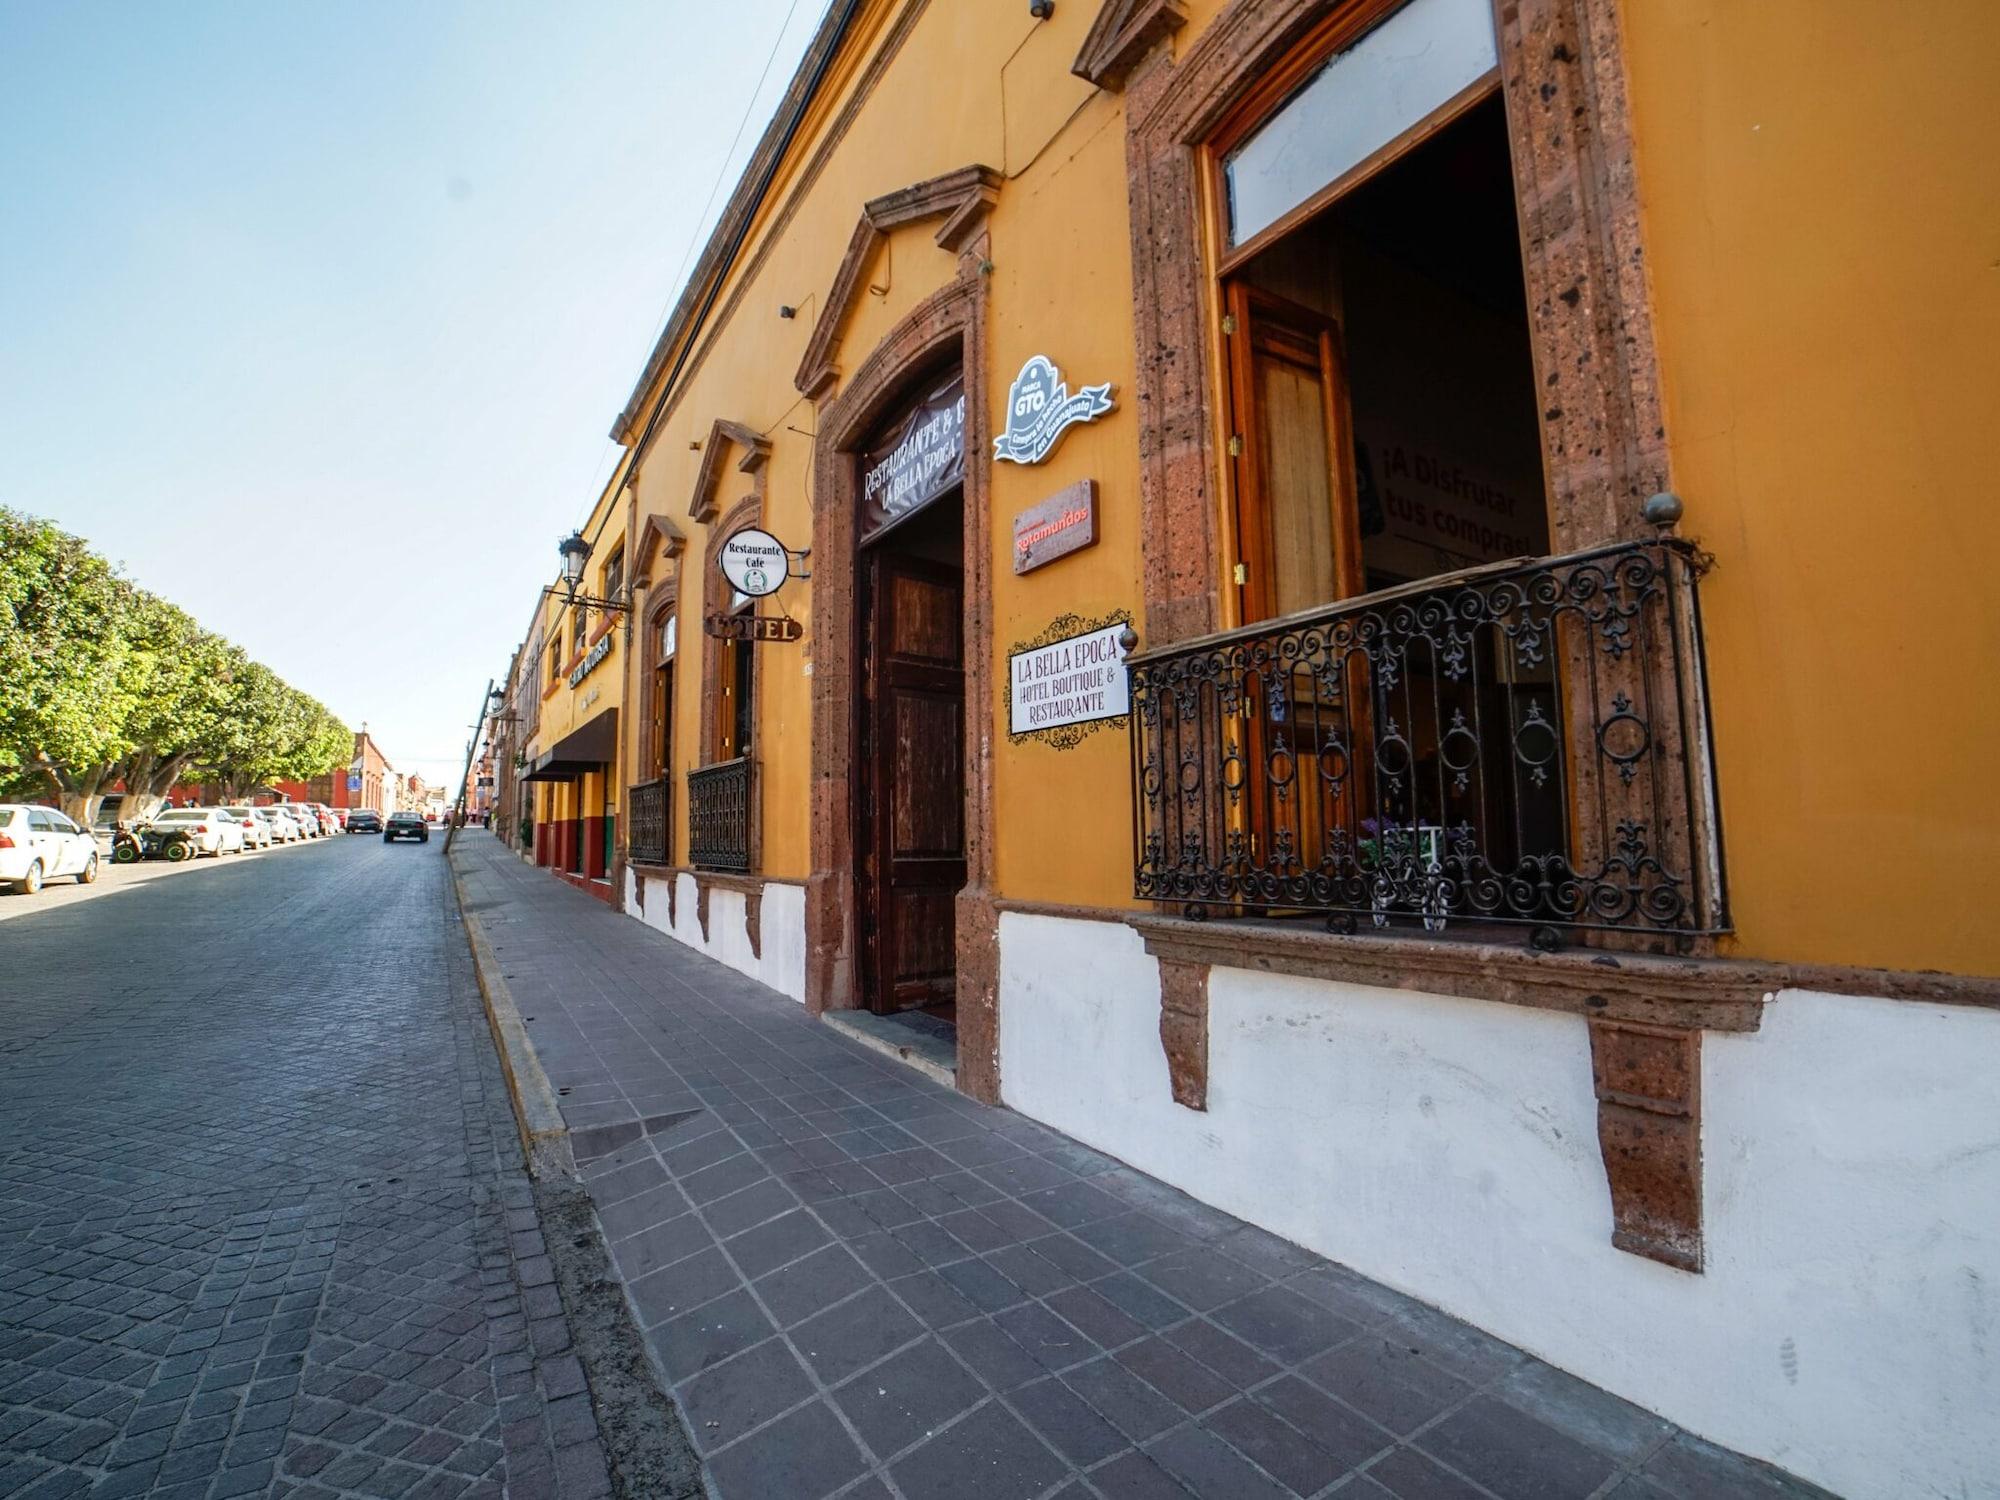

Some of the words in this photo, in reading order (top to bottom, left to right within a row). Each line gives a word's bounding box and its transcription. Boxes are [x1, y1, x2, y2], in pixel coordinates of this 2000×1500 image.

[1015, 390, 1045, 416] GTO
[1037, 437, 1047, 452] en
[1046, 400, 1090, 438] Guanajuato
[865, 416, 940, 501] RESTAURANTE
[942, 408, 952, 435] &
[894, 462, 922, 501] BELLA
[1017, 507, 1088, 551] Rotamundos
[729, 543, 781, 556] Restaurante
[1018, 660, 1032, 683] LA
[1035, 648, 1071, 678] BELLA
[1075, 635, 1117, 668] EPOCA
[1020, 682, 1049, 704] HOTEL
[1053, 667, 1104, 697] BOUTIQUE
[1107, 666, 1116, 683] &
[1029, 691, 1105, 725] RESTAURANTE
